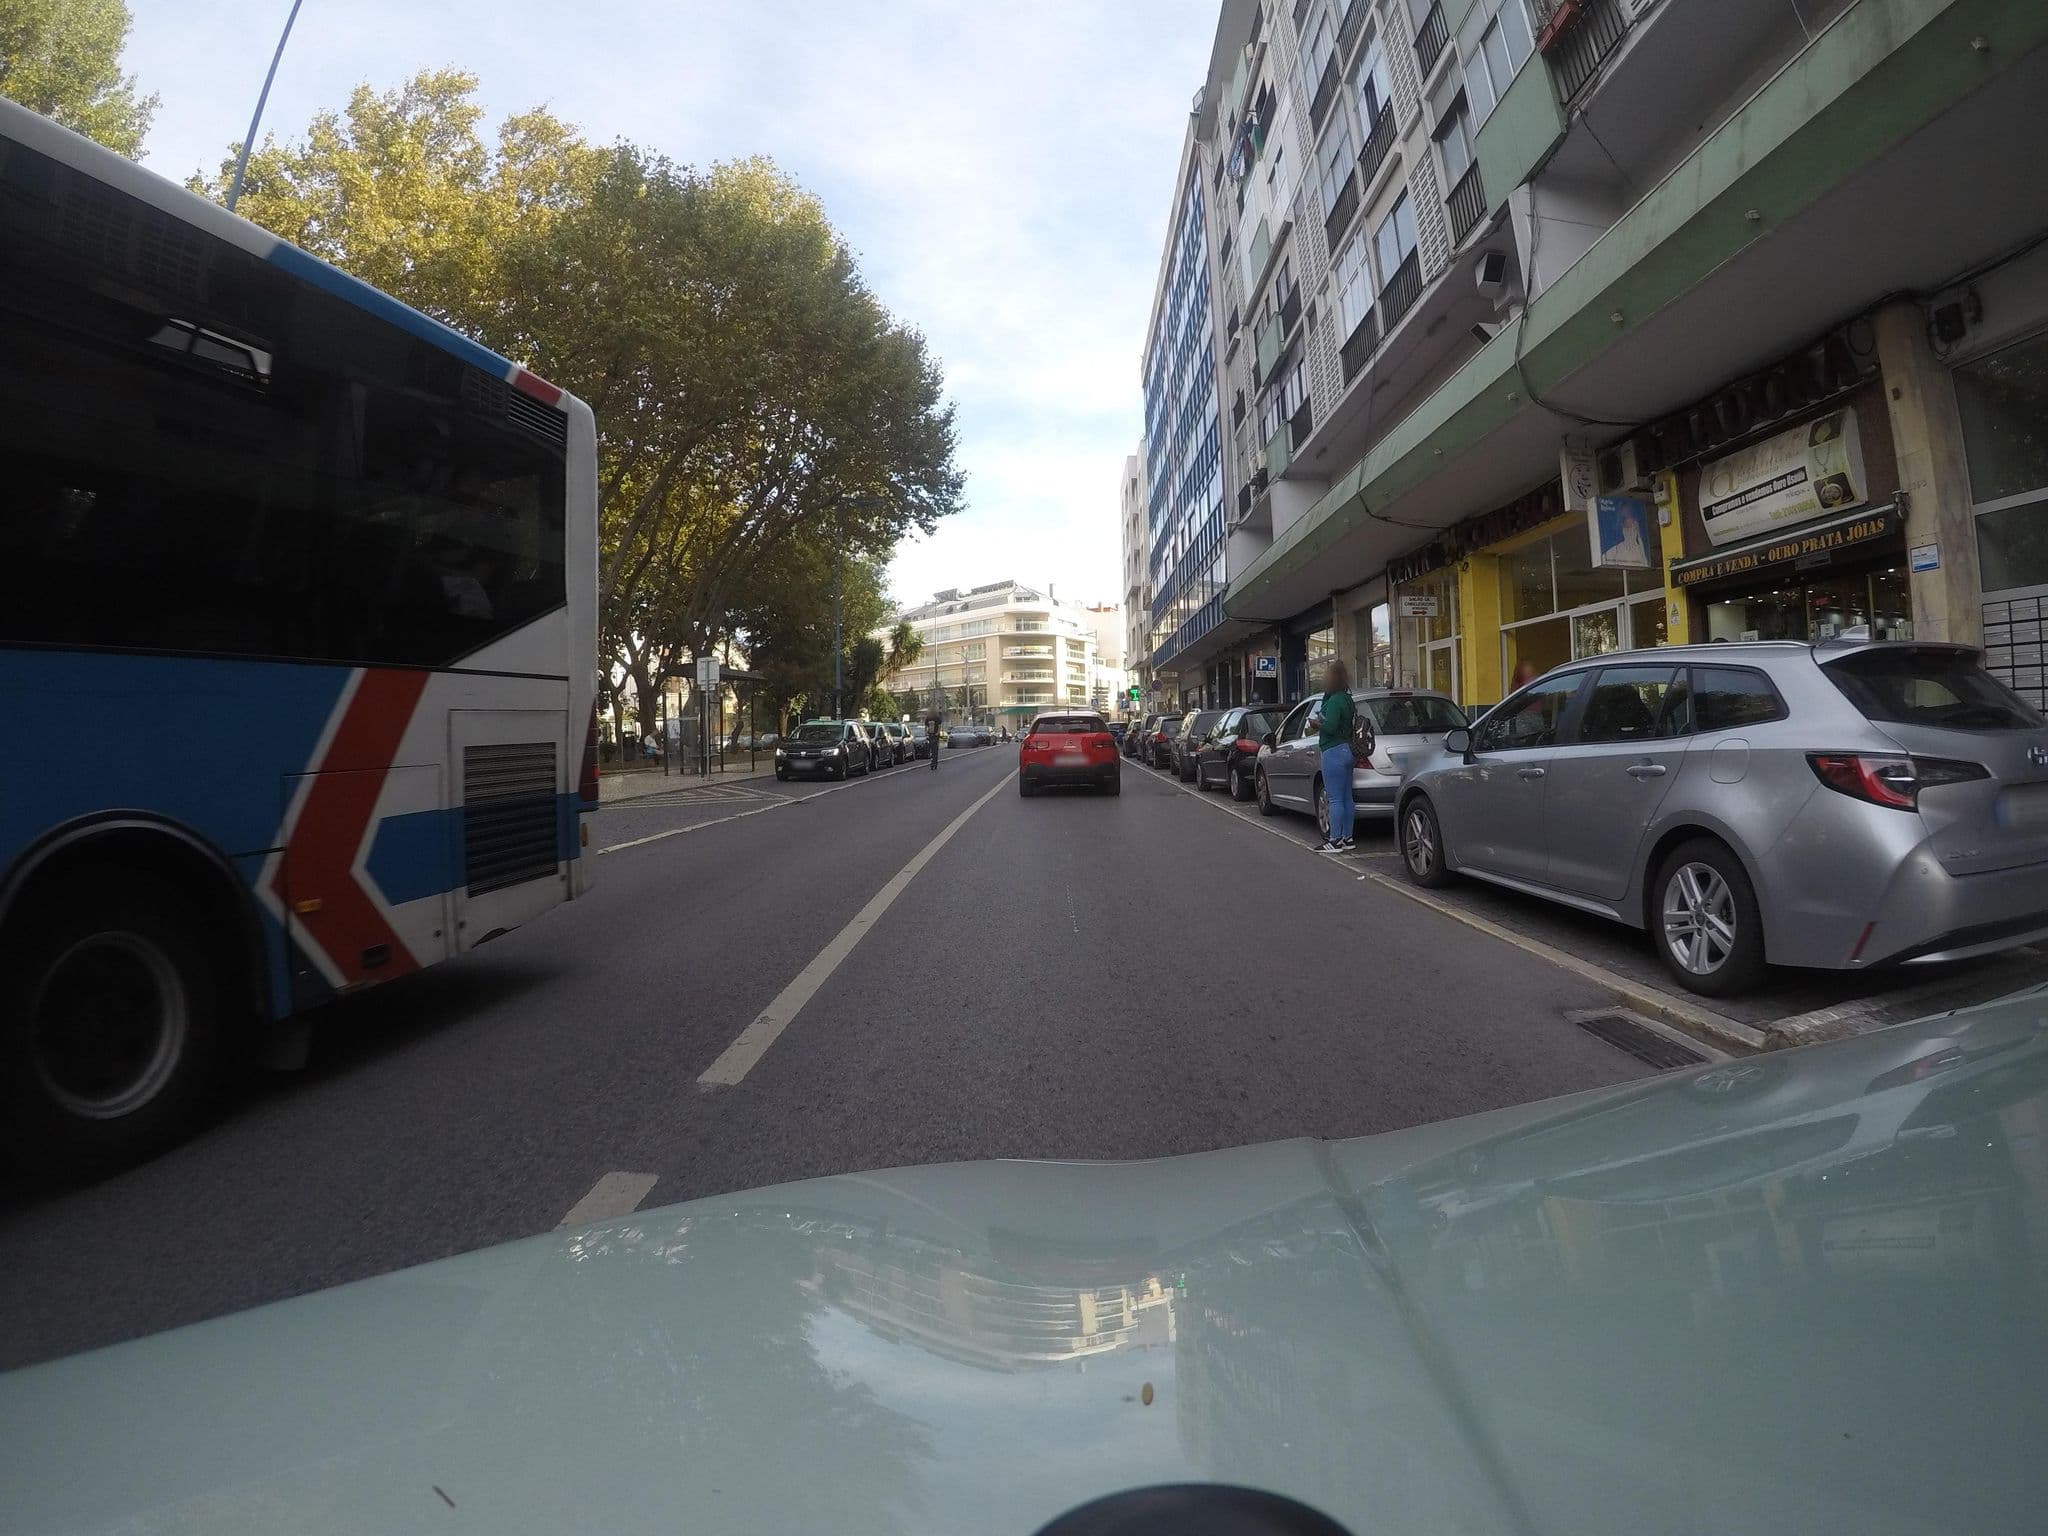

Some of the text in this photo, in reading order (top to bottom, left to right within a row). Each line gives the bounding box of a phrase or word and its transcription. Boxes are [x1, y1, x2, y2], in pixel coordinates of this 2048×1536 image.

[1678, 566, 1714, 583] COMPRA
[1716, 563, 1723, 575] E
[1726, 553, 1759, 572] VENDA
[1768, 542, 1799, 561] OURO
[1802, 531, 1843, 553] PRATA
[1847, 518, 1885, 541] JÓIAS
[1259, 658, 1268, 670] P
